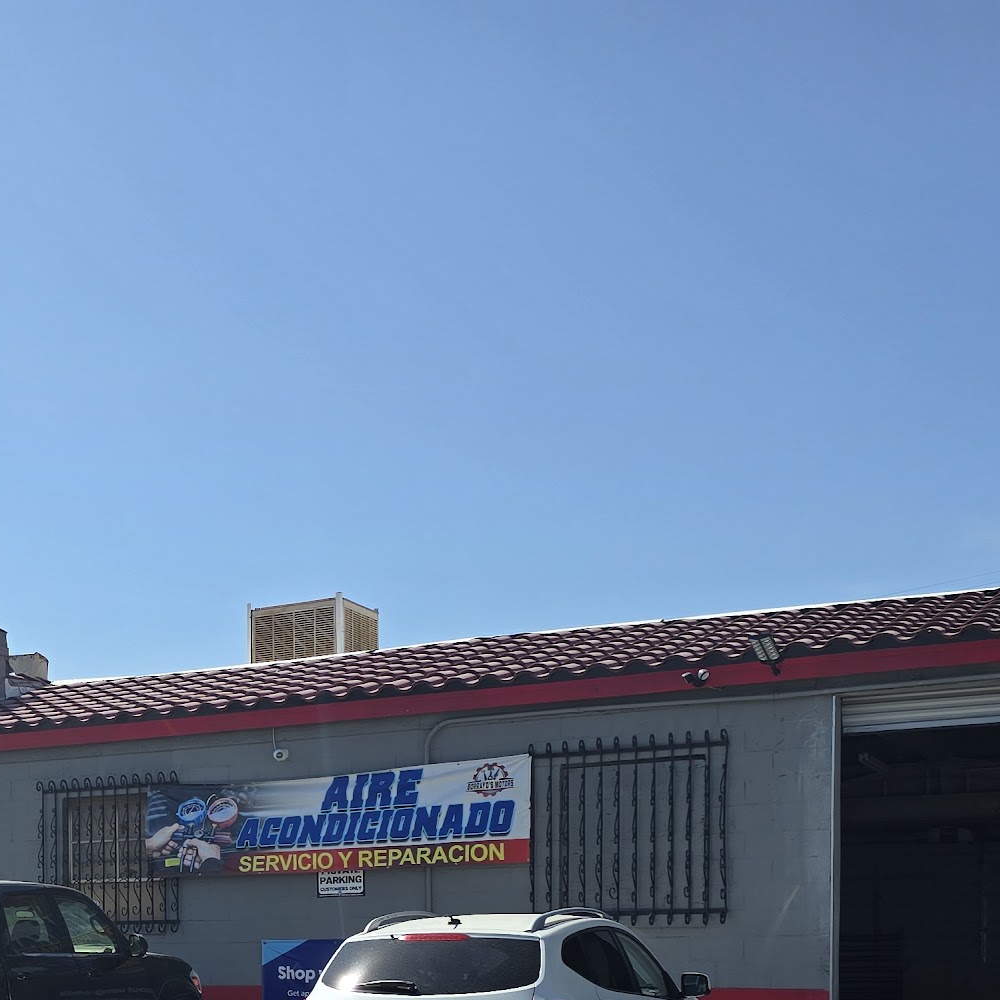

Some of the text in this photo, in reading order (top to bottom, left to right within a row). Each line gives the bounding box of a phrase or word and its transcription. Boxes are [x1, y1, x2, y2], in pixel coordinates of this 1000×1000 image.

[321, 769, 423, 812] AIRE
[467, 780, 514, 790] BORRAYO'S MOTORS
[236, 800, 515, 848] ACONDICIONADO
[239, 843, 505, 872] SERVICIO Y REPARACION
[320, 876, 362, 884] PARKING
[278, 965, 316, 983] Shop
[300, 991, 310, 999] ap
